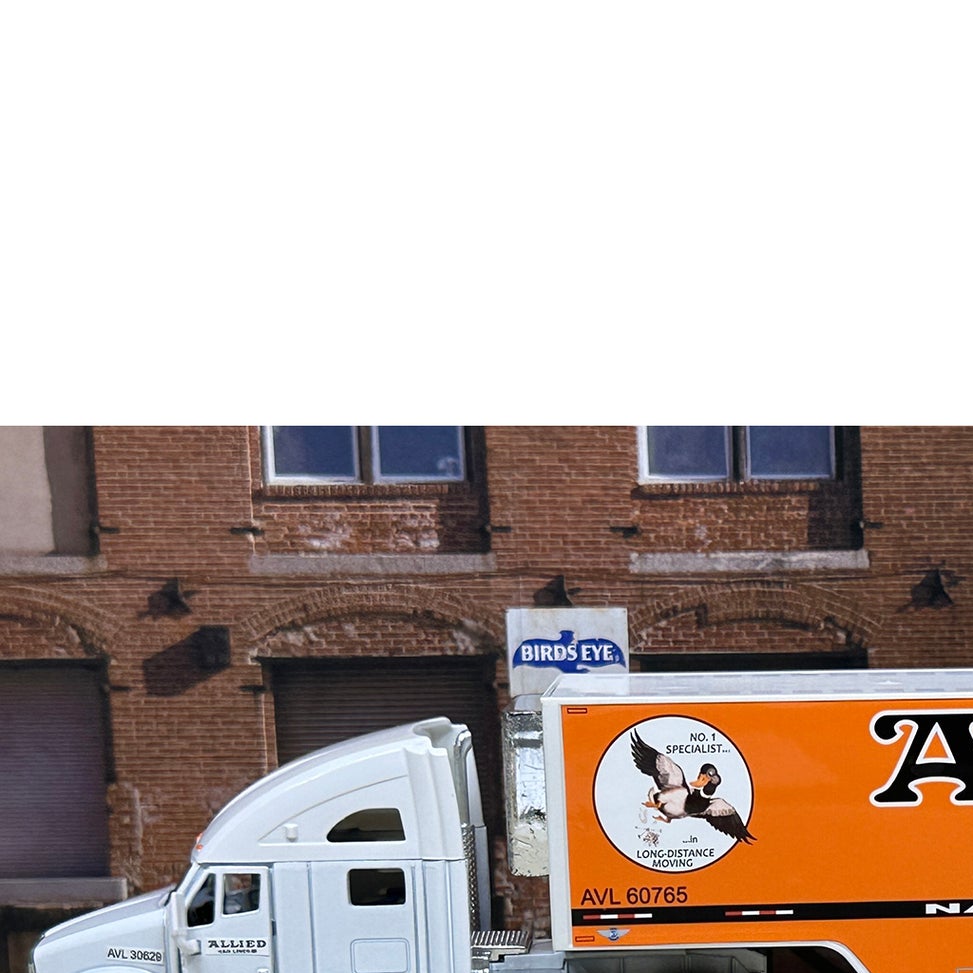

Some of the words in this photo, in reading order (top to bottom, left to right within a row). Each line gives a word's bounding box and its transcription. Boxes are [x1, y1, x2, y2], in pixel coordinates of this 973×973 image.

[521, 643, 578, 661] BIRDS
[581, 644, 614, 661] EYE
[690, 732, 708, 742] NO.
[711, 732, 716, 741] 1
[636, 848, 715, 859] LONG-DISTANCE
[652, 858, 693, 868] MOVING
[581, 888, 621, 906] AVL
[626, 886, 688, 904] 60765
[208, 940, 267, 948] ALLIED
[107, 948, 128, 959] AVL
